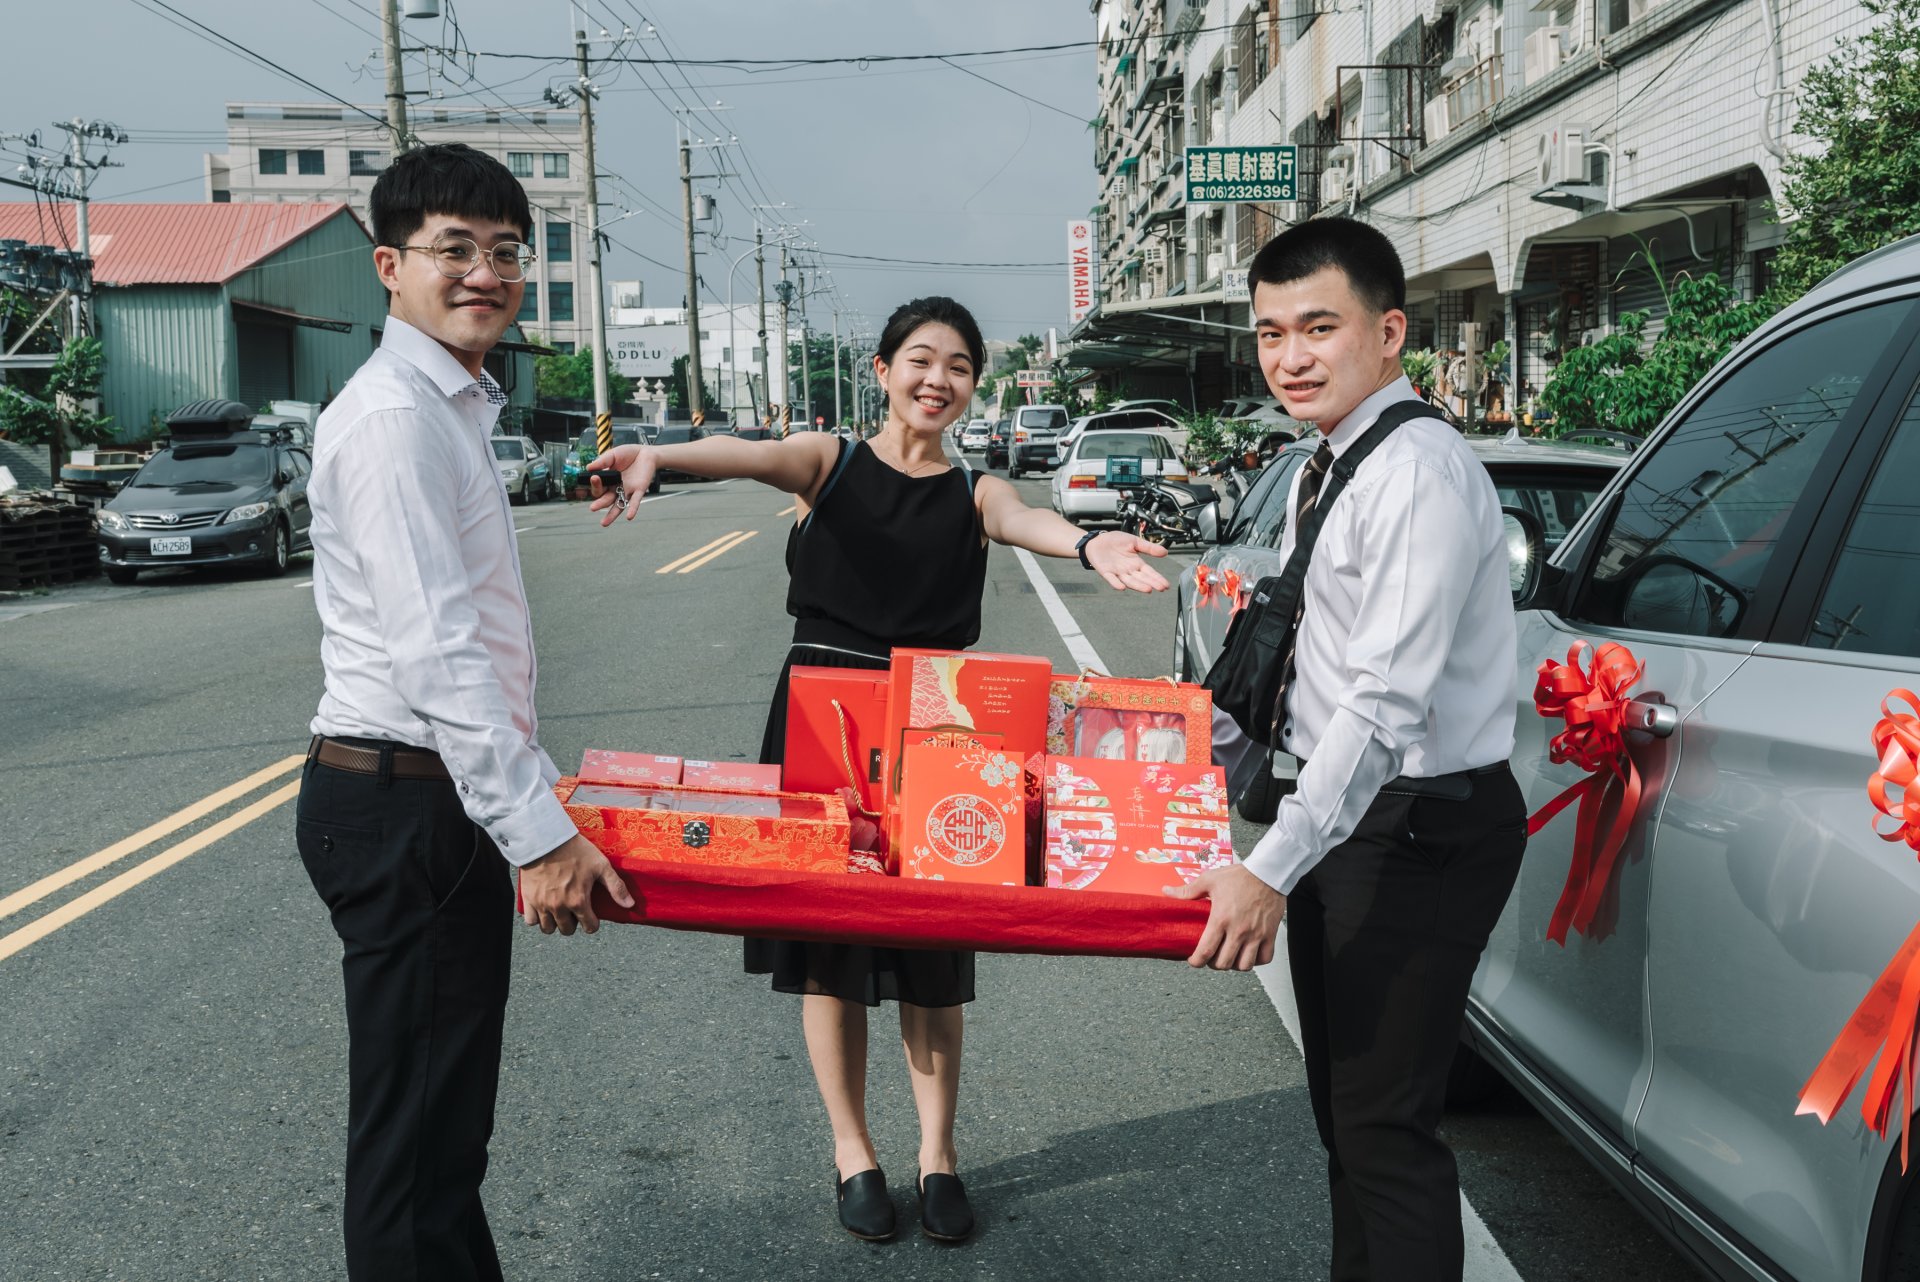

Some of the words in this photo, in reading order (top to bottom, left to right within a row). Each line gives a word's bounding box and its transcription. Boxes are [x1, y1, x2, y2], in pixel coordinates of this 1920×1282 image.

[1205, 185, 1291, 199] (06)2326396
[1073, 247, 1090, 308] YAMAHA
[1143, 771, 1176, 787] 男方
